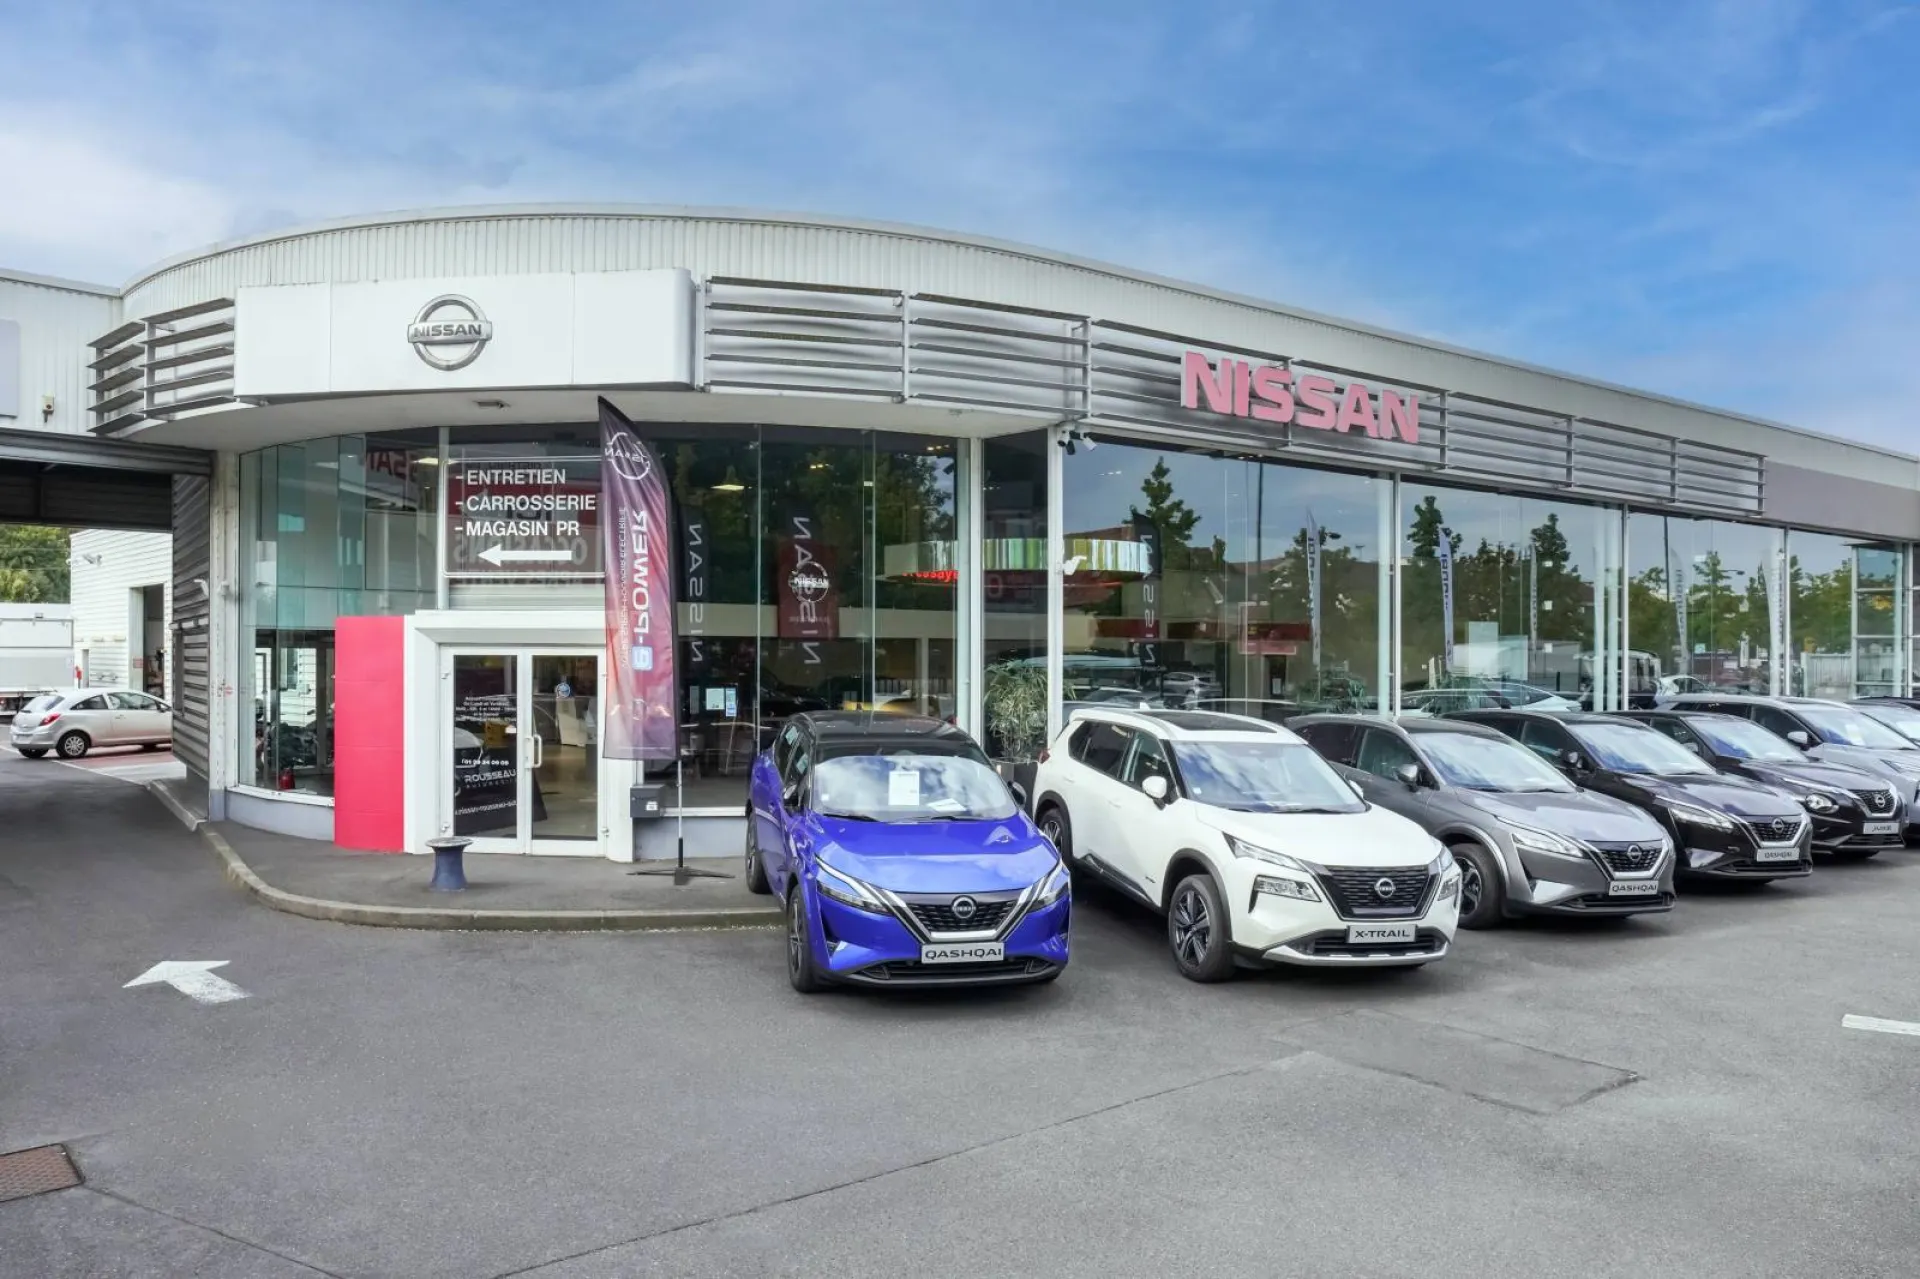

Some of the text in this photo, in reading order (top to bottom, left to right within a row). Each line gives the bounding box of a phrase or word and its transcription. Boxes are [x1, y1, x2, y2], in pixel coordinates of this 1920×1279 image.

[413, 323, 482, 338] NISSAN
[1180, 350, 1420, 444] NISSAN
[556, 521, 580, 536] PR
[464, 769, 516, 783] ROUSSEAU
[1612, 884, 1657, 892] QASHQAI
[1355, 930, 1410, 938] X-TRAIL
[925, 948, 1002, 960] QASHQAI
